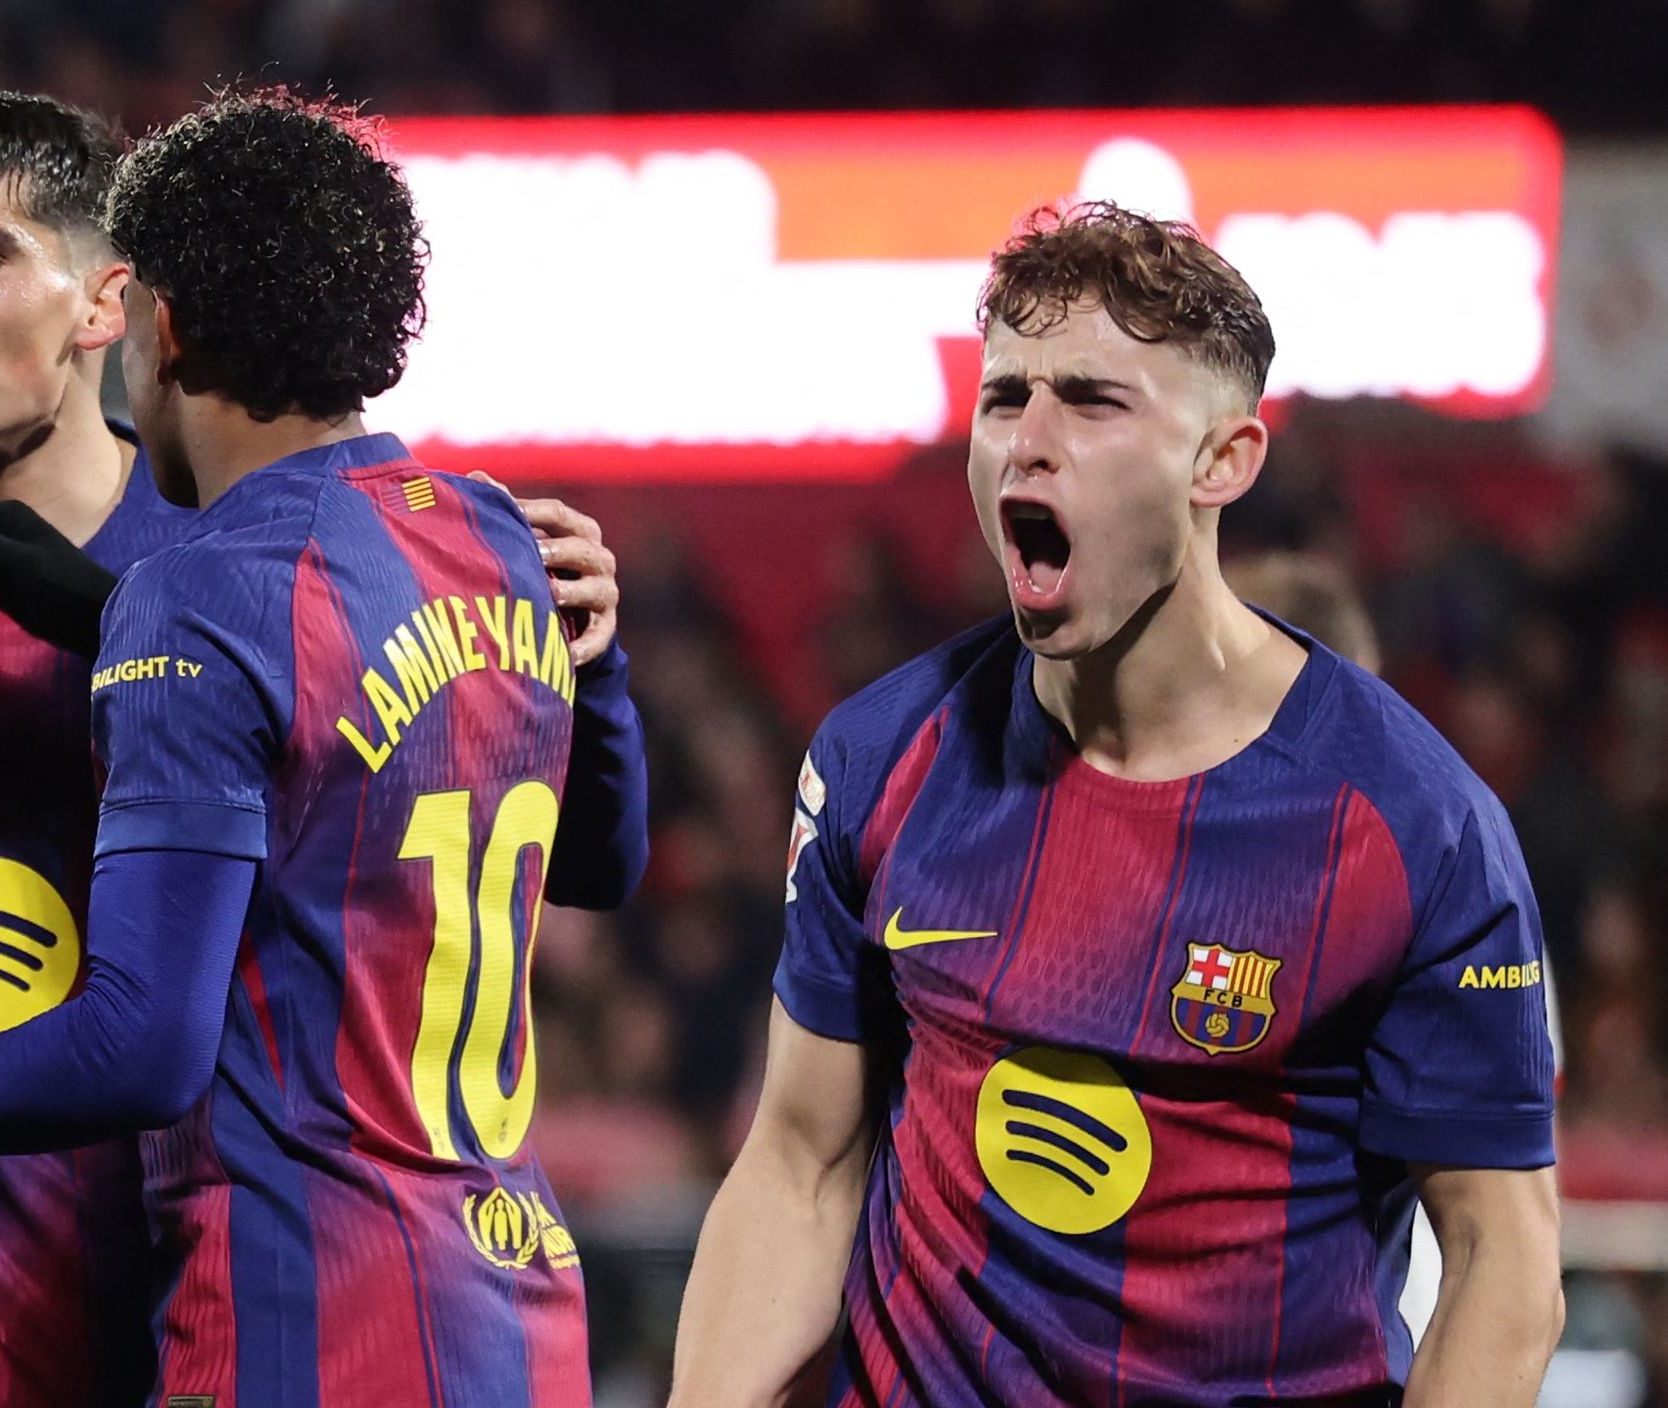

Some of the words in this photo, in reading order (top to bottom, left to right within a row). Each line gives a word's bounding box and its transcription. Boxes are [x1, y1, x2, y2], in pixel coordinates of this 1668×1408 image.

[175, 658, 203, 678] tv
[396, 779, 560, 1161] 10
[1203, 989, 1243, 1008] FCB
